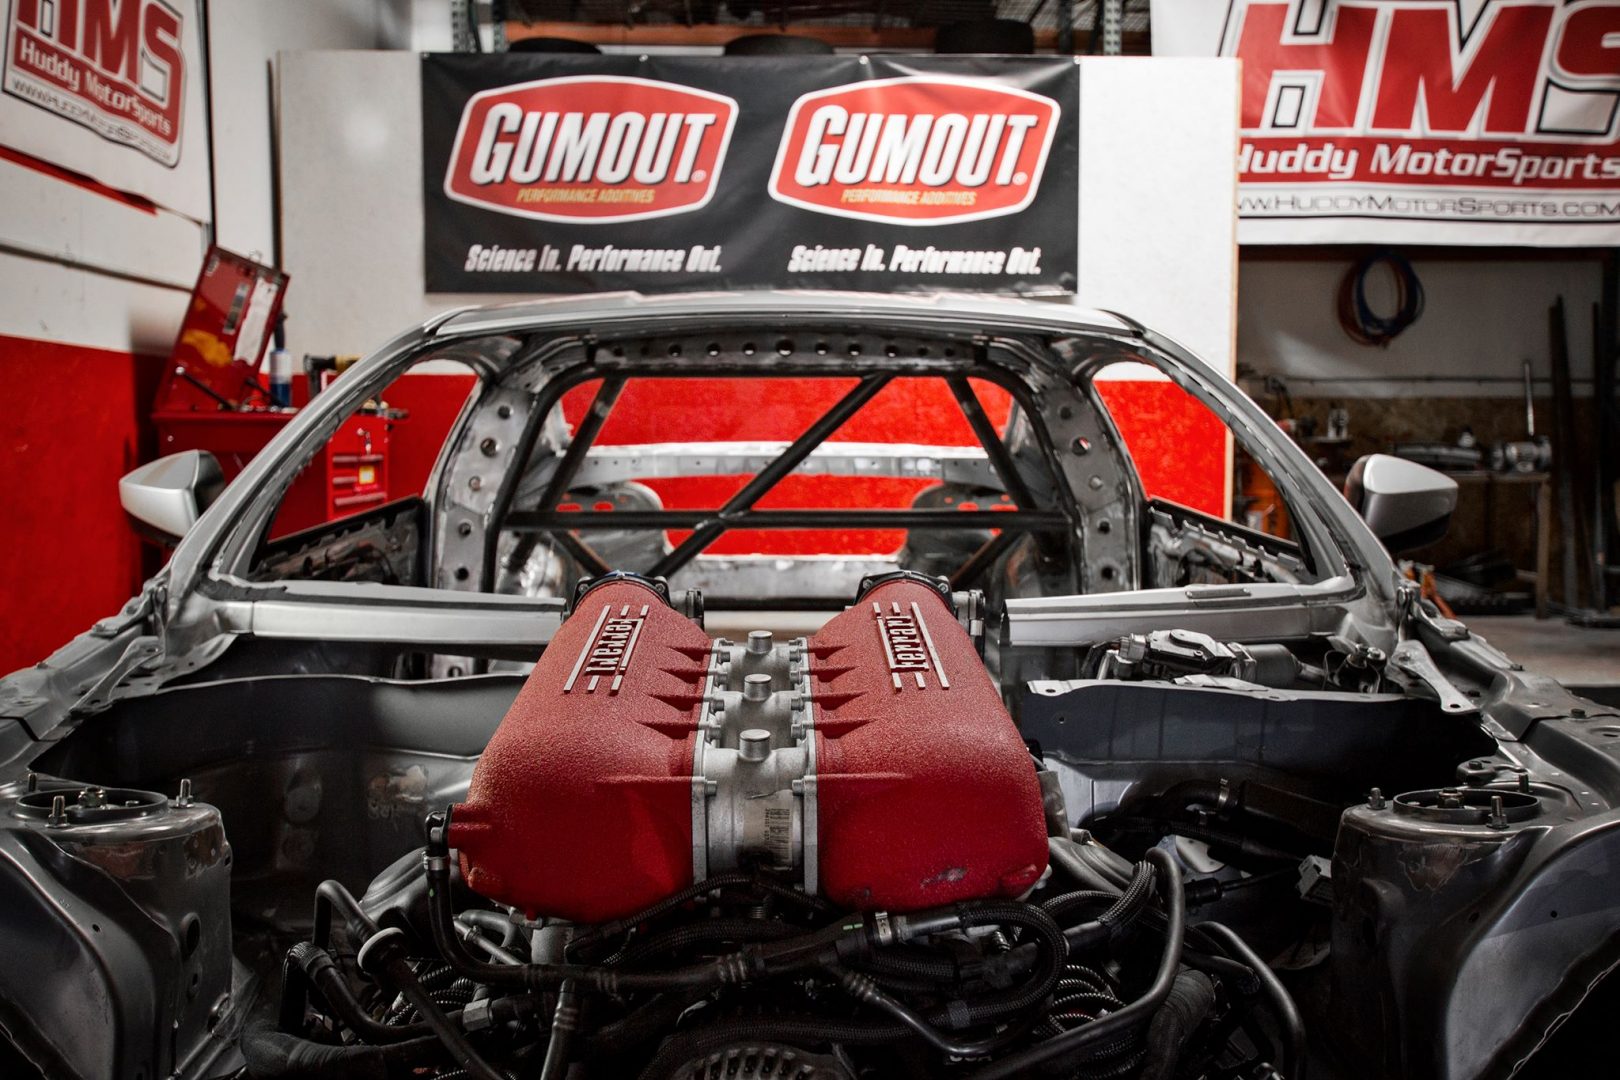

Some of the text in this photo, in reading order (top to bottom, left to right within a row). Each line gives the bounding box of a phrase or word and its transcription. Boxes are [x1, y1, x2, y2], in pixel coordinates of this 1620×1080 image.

[19, 38, 80, 92] Huddy
[469, 102, 716, 185] GUMOUT
[794, 104, 1038, 187] GUMOUT
[1370, 143, 1620, 185] MotorSports
[516, 188, 655, 204] PERFORMANCE ADDITIVES
[841, 189, 977, 206] PERFORMANCE ADDITIVES
[464, 244, 722, 272] Science In. Performance Out.
[788, 243, 1042, 275] Science In. Performance Out.
